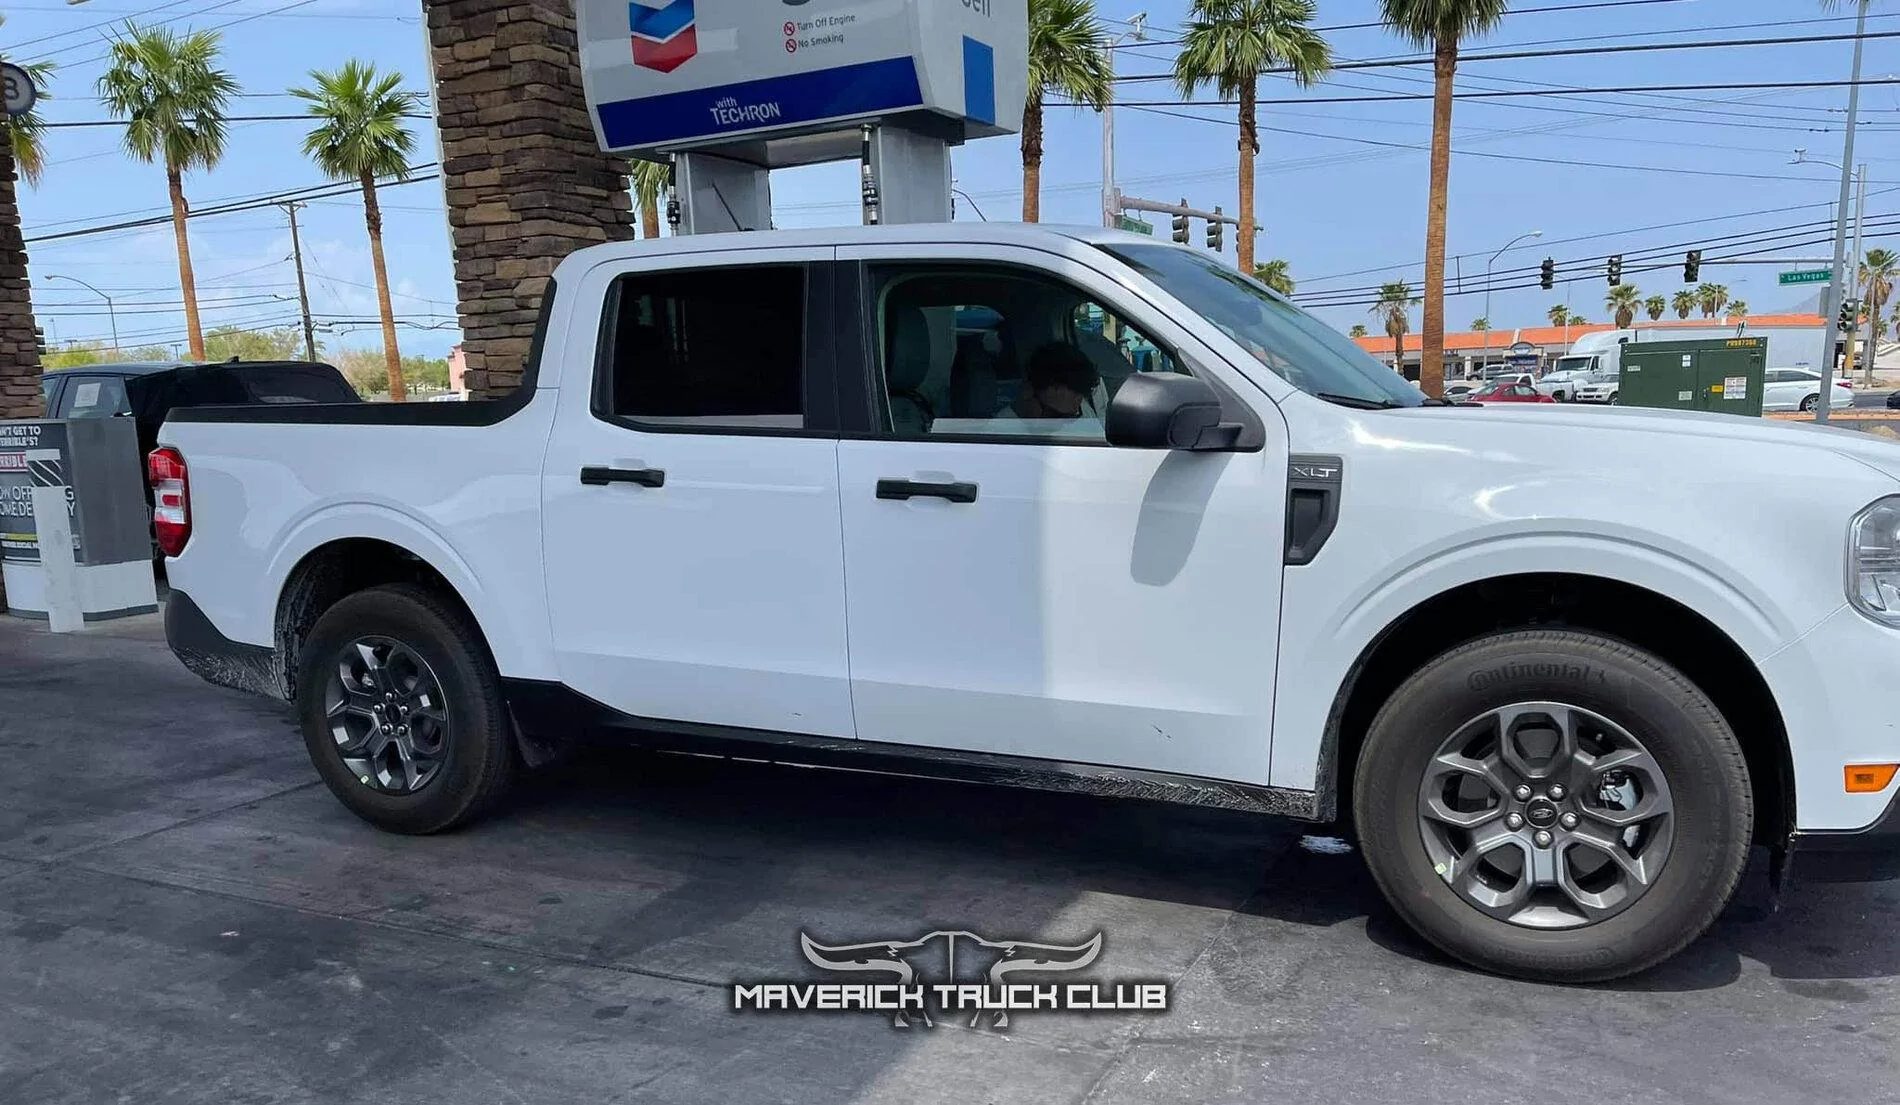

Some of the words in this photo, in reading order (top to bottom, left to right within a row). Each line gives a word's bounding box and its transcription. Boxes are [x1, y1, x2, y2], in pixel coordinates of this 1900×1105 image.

[797, 22, 813, 31] Turn
[815, 18, 827, 28] Off
[829, 14, 856, 26] Engine
[798, 40, 809, 48] No
[811, 34, 844, 47] Smoking
[715, 96, 738, 109] with
[710, 101, 781, 125] TECHRON
[28, 425, 41, 436] TO
[1293, 466, 1338, 478] XLT
